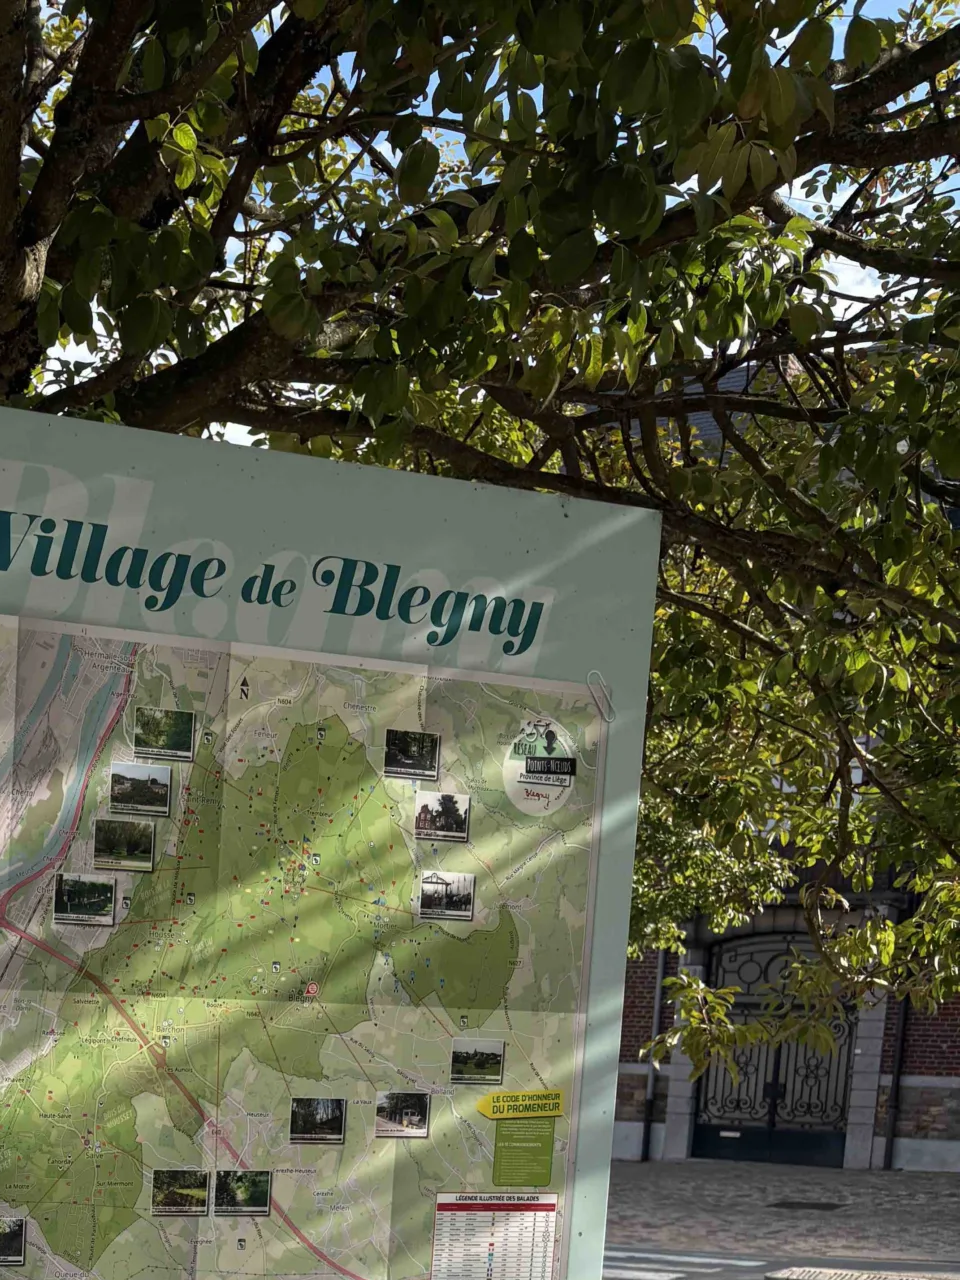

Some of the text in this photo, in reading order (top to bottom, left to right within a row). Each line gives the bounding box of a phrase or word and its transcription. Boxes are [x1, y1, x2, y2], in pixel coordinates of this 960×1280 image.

[240, 562, 297, 608] de
[311, 554, 546, 657] Blegny
[91, 663, 131, 674] Argenteau
[343, 702, 377, 712] Chenestre
[253, 730, 278, 739] Feneur
[513, 742, 537, 756] RÉSEAU
[519, 773, 544, 781] Province
[552, 775, 567, 784] Liège
[524, 788, 550, 806] Blegny
[373, 922, 397, 930] Mortier
[148, 931, 175, 939] Housse
[156, 1026, 185, 1034] Barchon
[430, 1088, 455, 1096] Bolland
[492, 1093, 561, 1103] LE CODE D'HONNEUR
[492, 1102, 561, 1115] DU PROMENEUR
[39, 1112, 72, 1120] Haute-Saive
[85, 1151, 104, 1160] Saive
[455, 1193, 540, 1202] LÉGENDE ILLUSTRÉE DES BALADES
[329, 1204, 350, 1212] Melen
